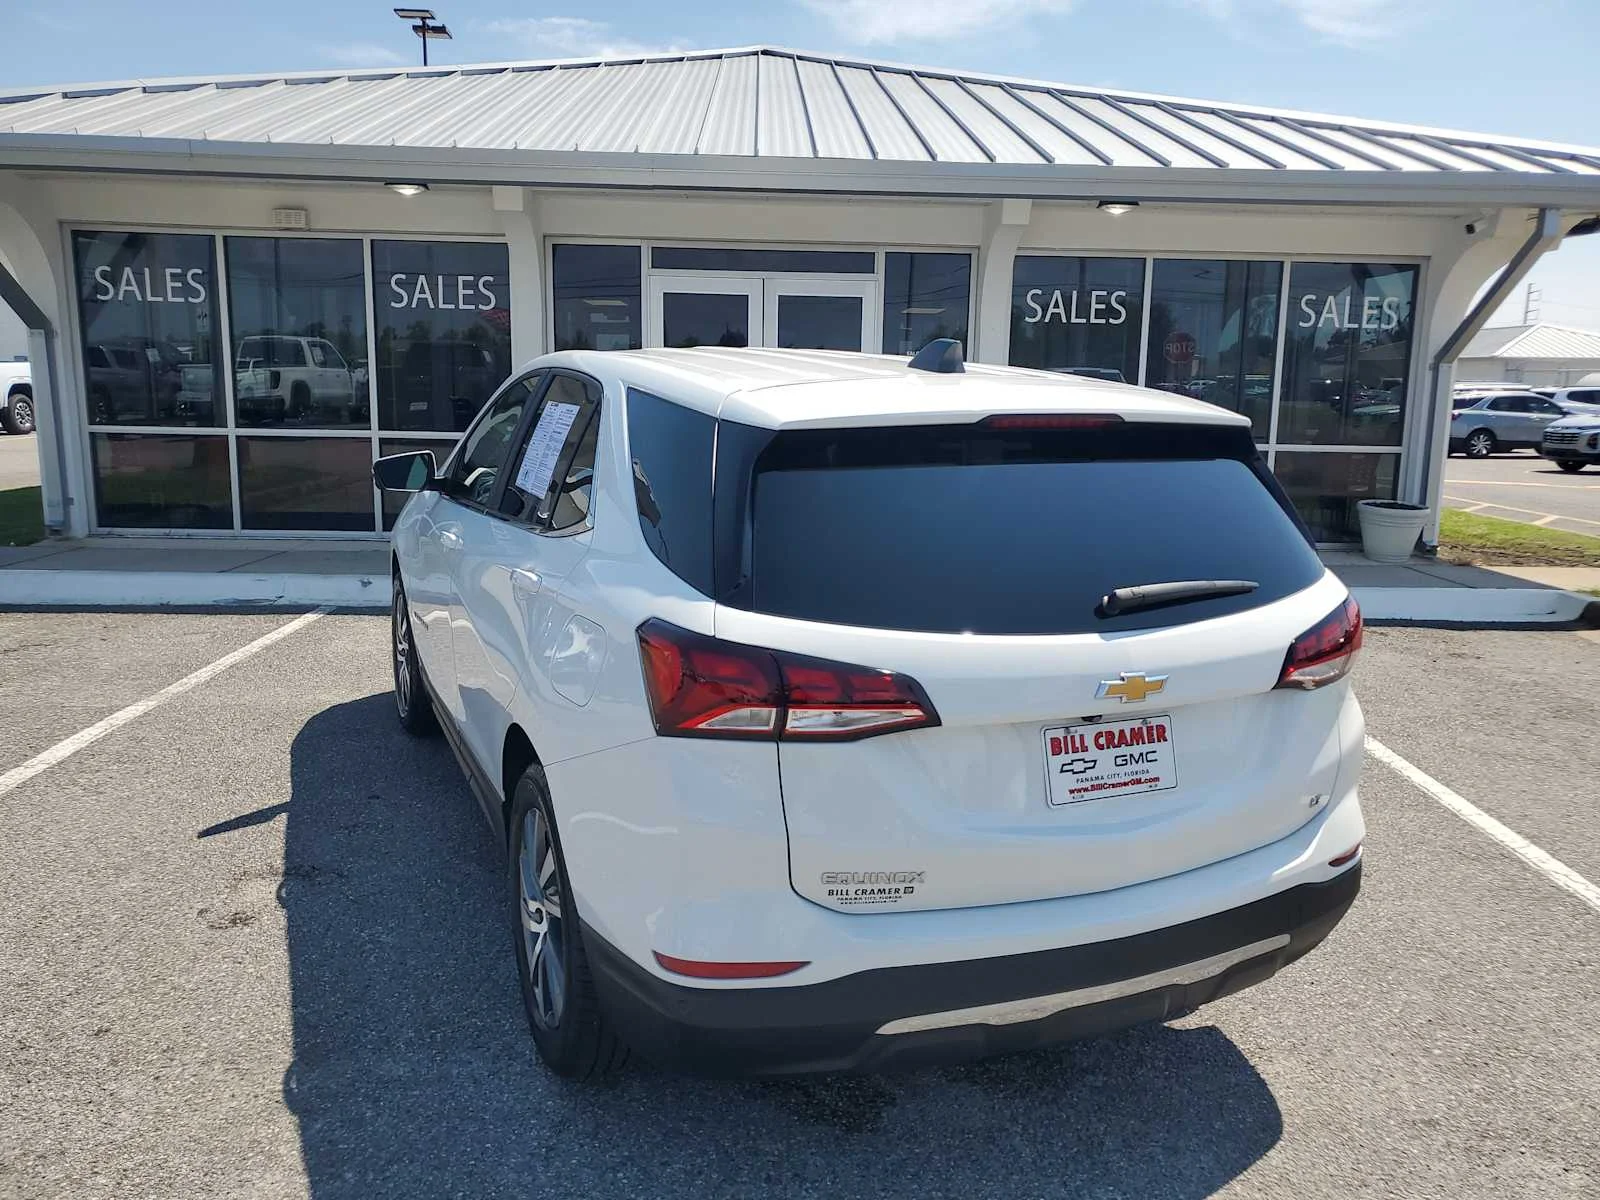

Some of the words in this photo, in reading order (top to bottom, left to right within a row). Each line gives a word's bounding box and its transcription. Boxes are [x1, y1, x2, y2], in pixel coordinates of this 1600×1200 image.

[94, 265, 207, 304] SALES
[389, 273, 497, 310] SALES
[1024, 289, 1127, 324] SALES
[1298, 294, 1400, 330] SALES
[1050, 734, 1089, 756] BILL
[1094, 724, 1168, 751] CRAMER
[1114, 751, 1158, 767] GMC
[1076, 776, 1104, 784] PANAMA
[1124, 769, 1150, 777] FLORIDA
[821, 871, 926, 885] EQUINOX
[828, 889, 849, 897] BILL
